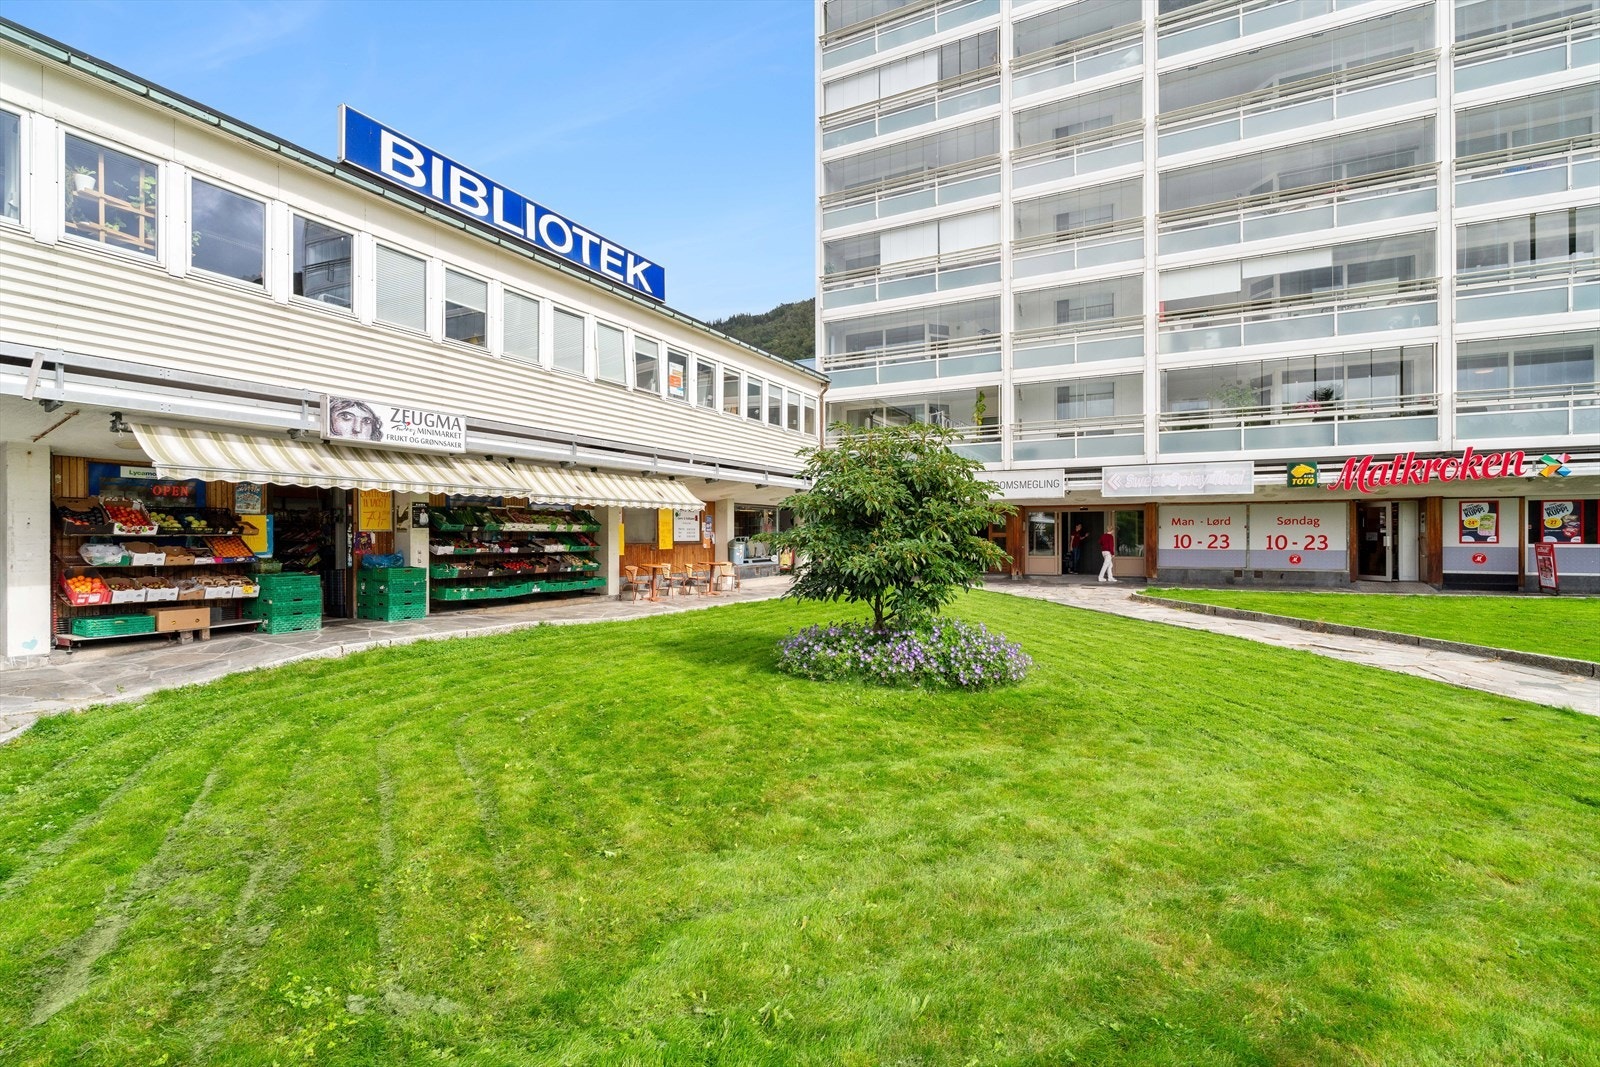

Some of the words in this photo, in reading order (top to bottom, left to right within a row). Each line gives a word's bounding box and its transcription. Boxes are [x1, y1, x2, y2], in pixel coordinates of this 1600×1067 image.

[380, 128, 653, 294] BIBLIOTEK
[390, 408, 461, 431] ZEUGMA
[417, 427, 462, 439] MINIMARKET
[386, 433, 408, 443] FRUKT
[409, 435, 420, 444] OG
[420, 437, 462, 448] GRØNNSAKER
[1326, 446, 1528, 494] Matkroken
[1292, 477, 1315, 485] TOTO
[152, 485, 189, 497] OPEN
[1464, 506, 1485, 518] KUPP!
[1546, 505, 1569, 517] KUPP!
[1171, 517, 1195, 526] Man
[1206, 516, 1231, 526] Lørd
[1276, 516, 1320, 528] Søndag
[1173, 534, 1192, 549] 10
[1207, 534, 1230, 549] 23
[1266, 534, 1288, 551] 10
[1303, 534, 1329, 551] 23
